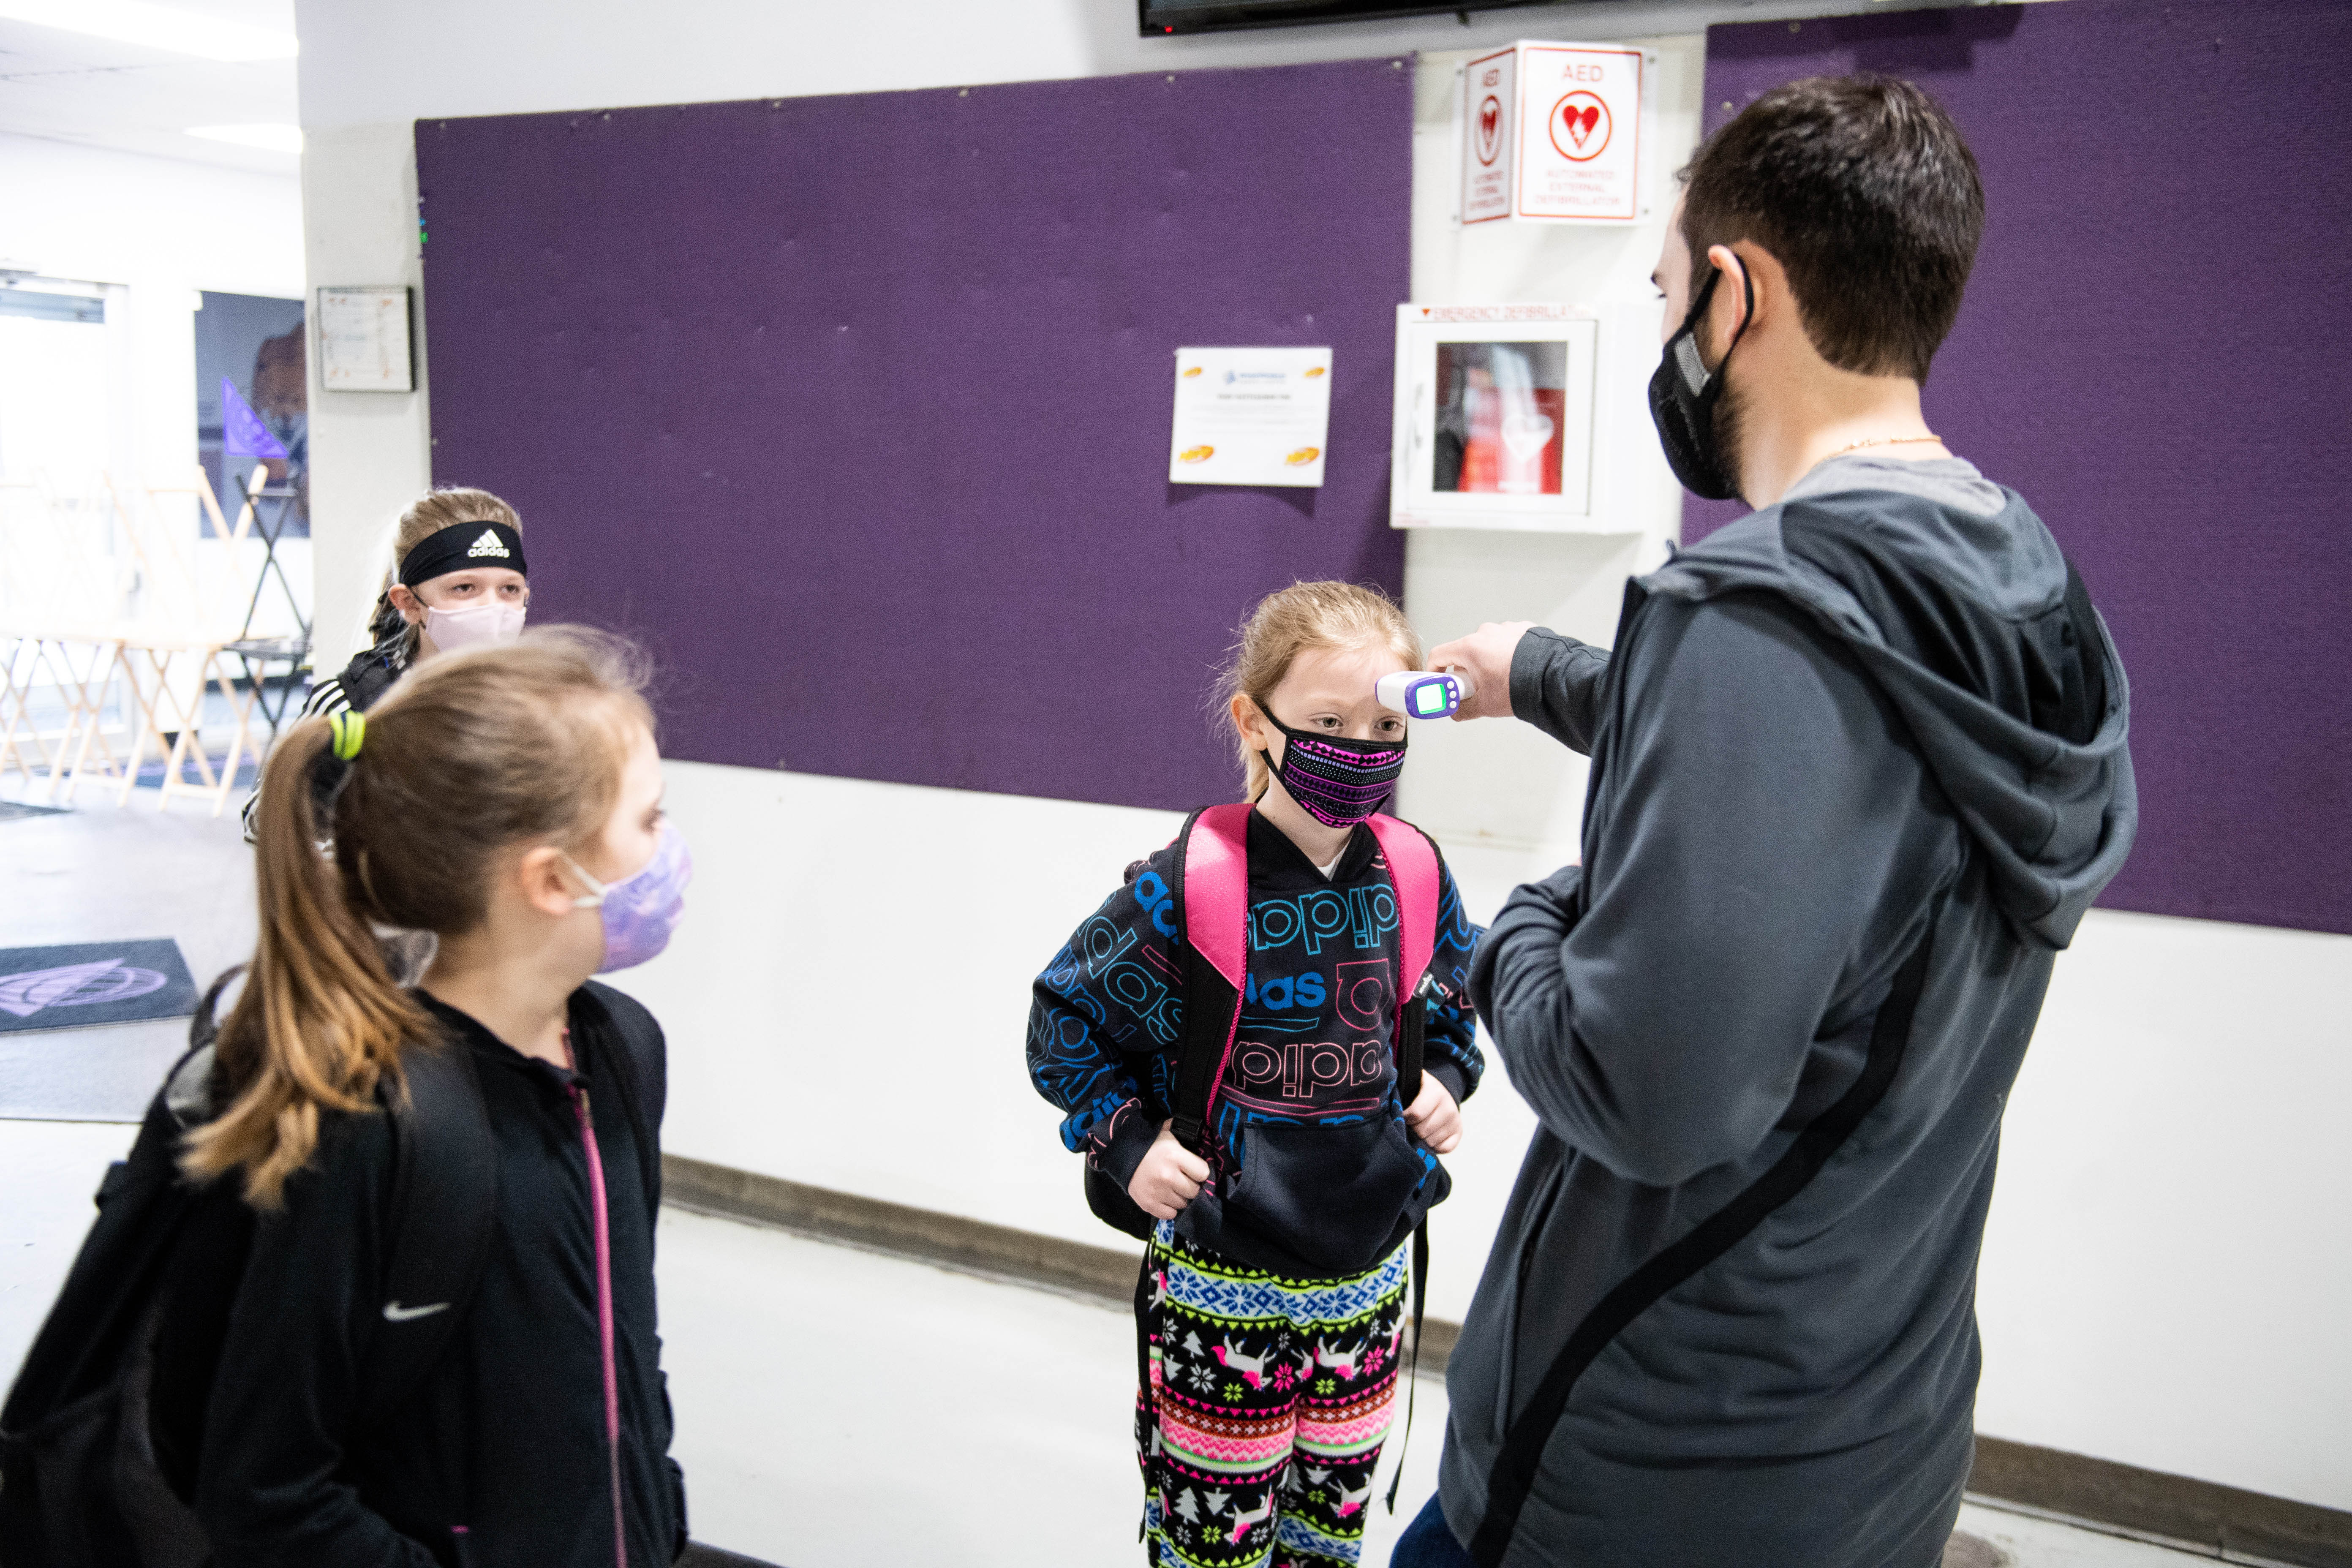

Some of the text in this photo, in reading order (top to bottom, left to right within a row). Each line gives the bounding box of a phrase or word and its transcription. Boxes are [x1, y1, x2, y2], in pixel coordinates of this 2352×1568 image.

[1562, 65, 1604, 82] AED
[1546, 169, 1615, 180] AUTOMATED
[1549, 182, 1605, 193] EXTERNAL
[1534, 194, 1621, 205] DEFIBRILLATOR
[1434, 307, 1499, 320] EMERGENCY
[467, 547, 510, 558] adidas
